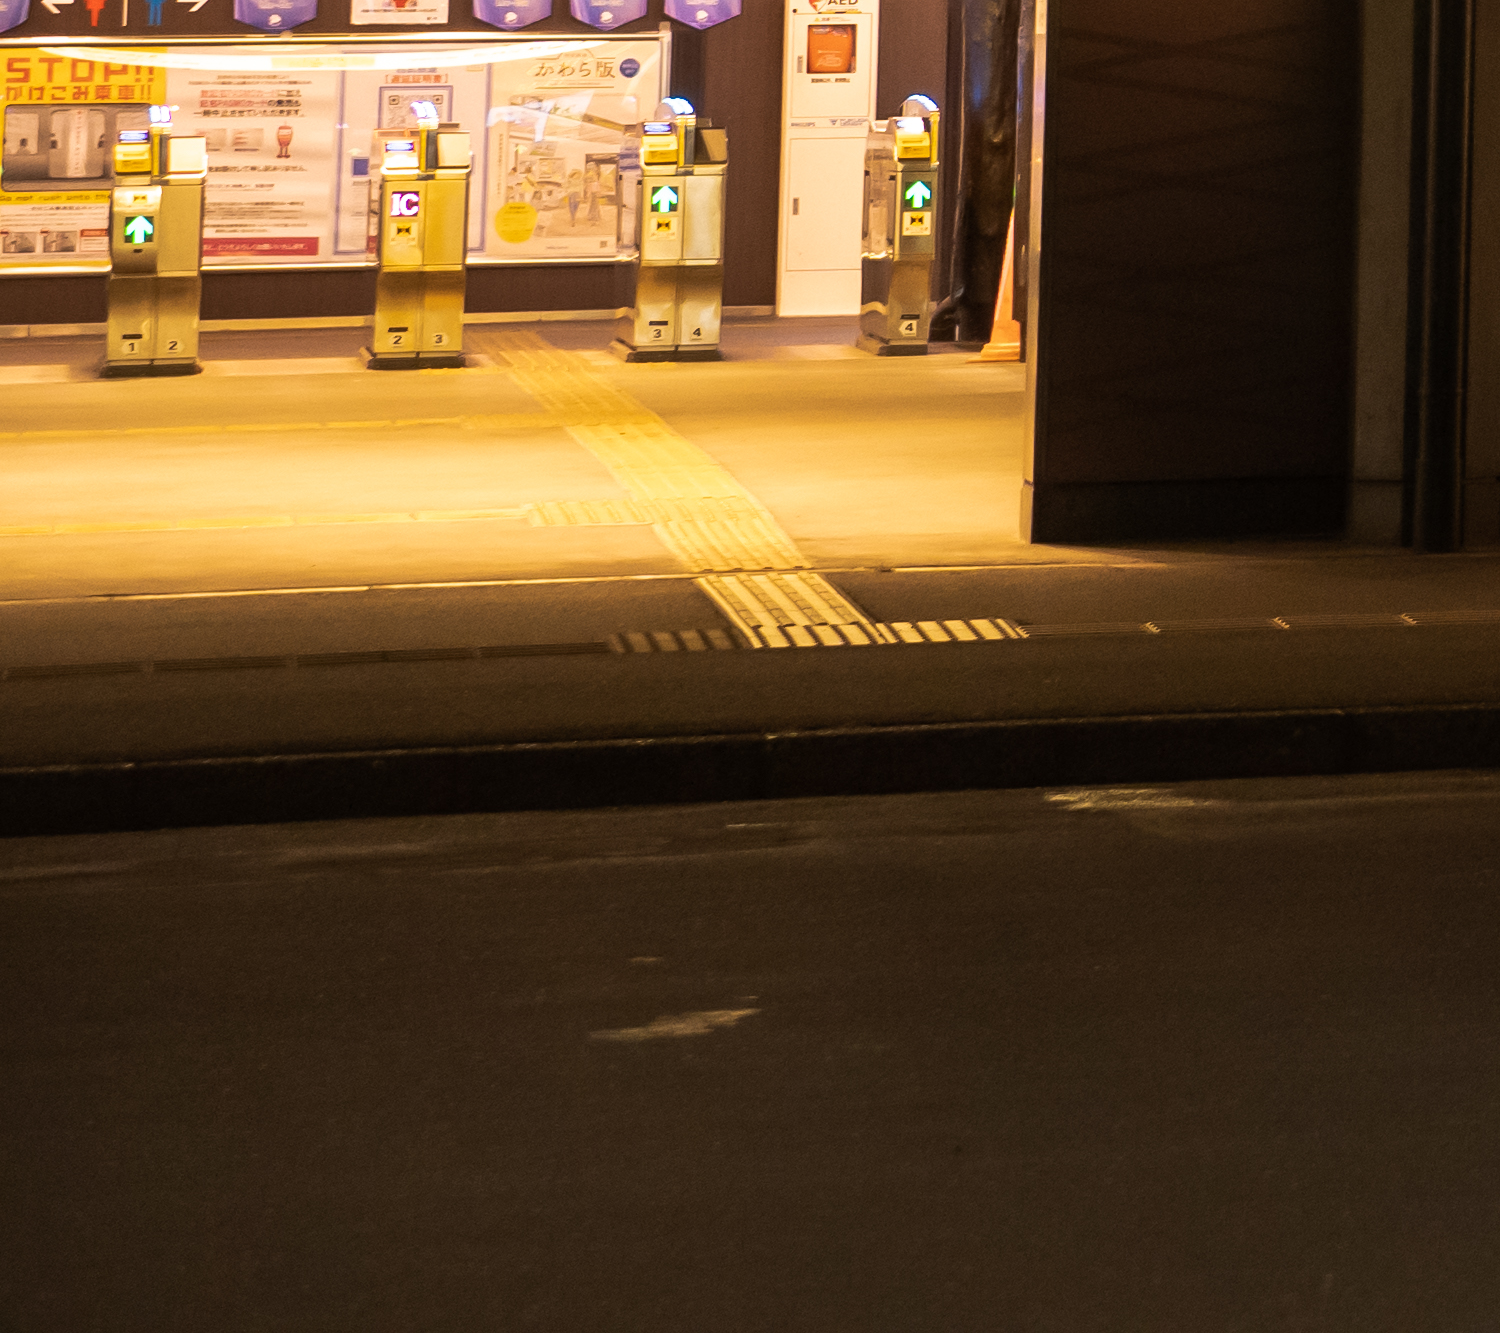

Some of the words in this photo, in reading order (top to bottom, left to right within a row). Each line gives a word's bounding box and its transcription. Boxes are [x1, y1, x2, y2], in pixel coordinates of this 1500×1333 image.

[6, 57, 154, 83] STOP!!
[535, 61, 616, 78] かわら版
[390, 192, 420, 216] IC
[905, 322, 914, 332] 4
[653, 329, 661, 339] 3
[692, 327, 702, 338] 4
[393, 335, 403, 345] 2
[434, 334, 443, 344] 3
[128, 343, 136, 352] 1
[168, 341, 178, 351] 2
